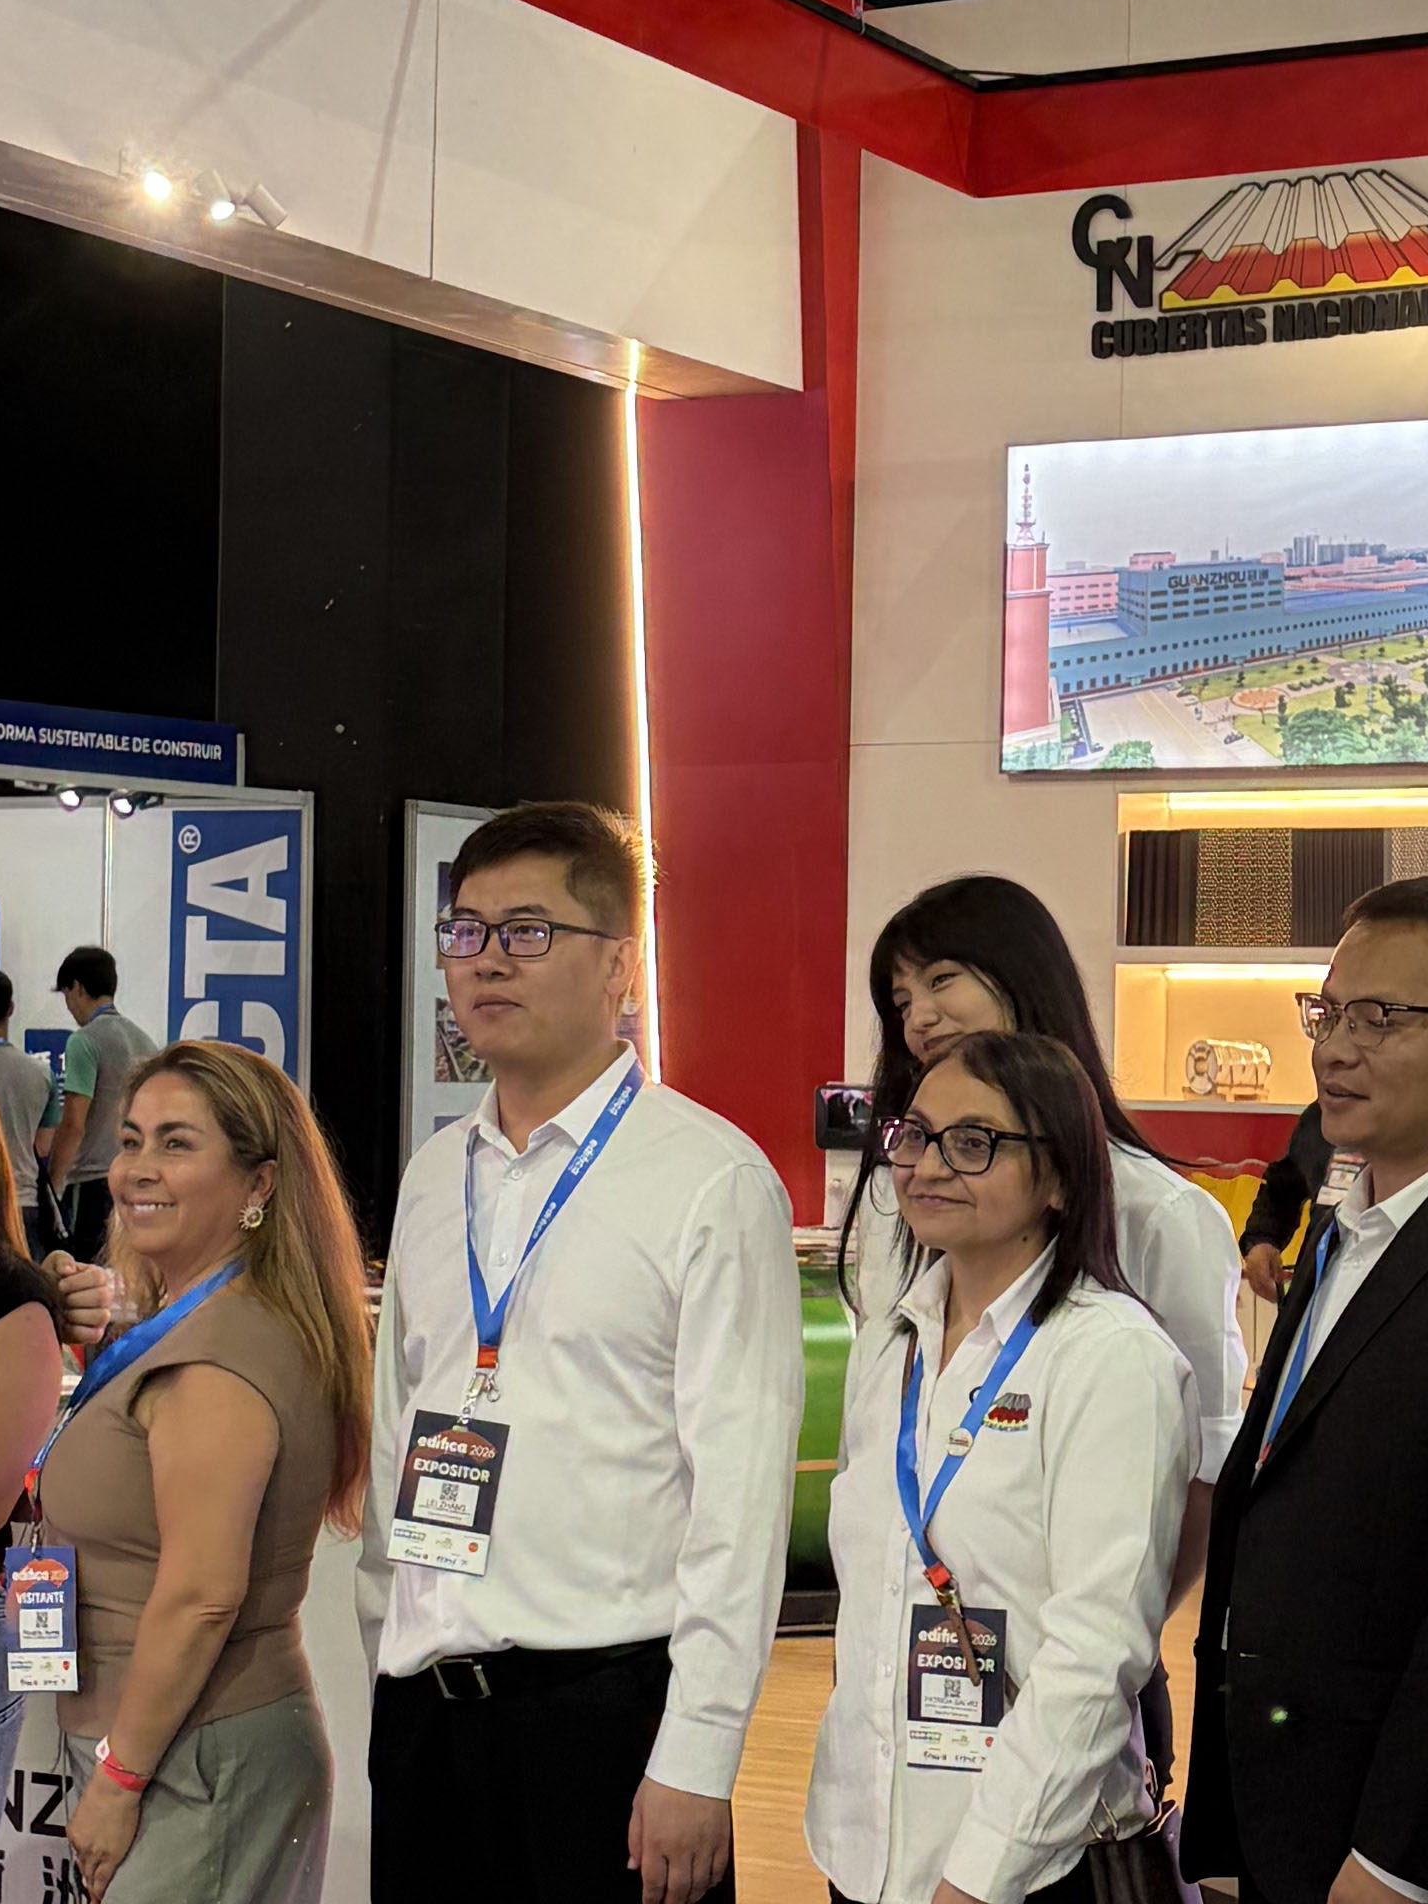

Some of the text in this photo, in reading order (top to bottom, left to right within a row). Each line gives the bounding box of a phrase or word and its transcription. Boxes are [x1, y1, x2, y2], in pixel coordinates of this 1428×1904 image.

[1090, 306, 1267, 359] CUBIERTAS
[1167, 569, 1246, 589] GUANZHOU
[38, 726, 131, 752] SUSTENTABLE
[132, 736, 151, 754] DE
[152, 739, 222, 761] CONSTRUIR
[416, 1434, 496, 1459] edifica 2026
[413, 1457, 491, 1483] EXPOSITOR
[918, 1627, 997, 1647] edific 2026
[916, 1653, 995, 1673] EXPOSIOR
